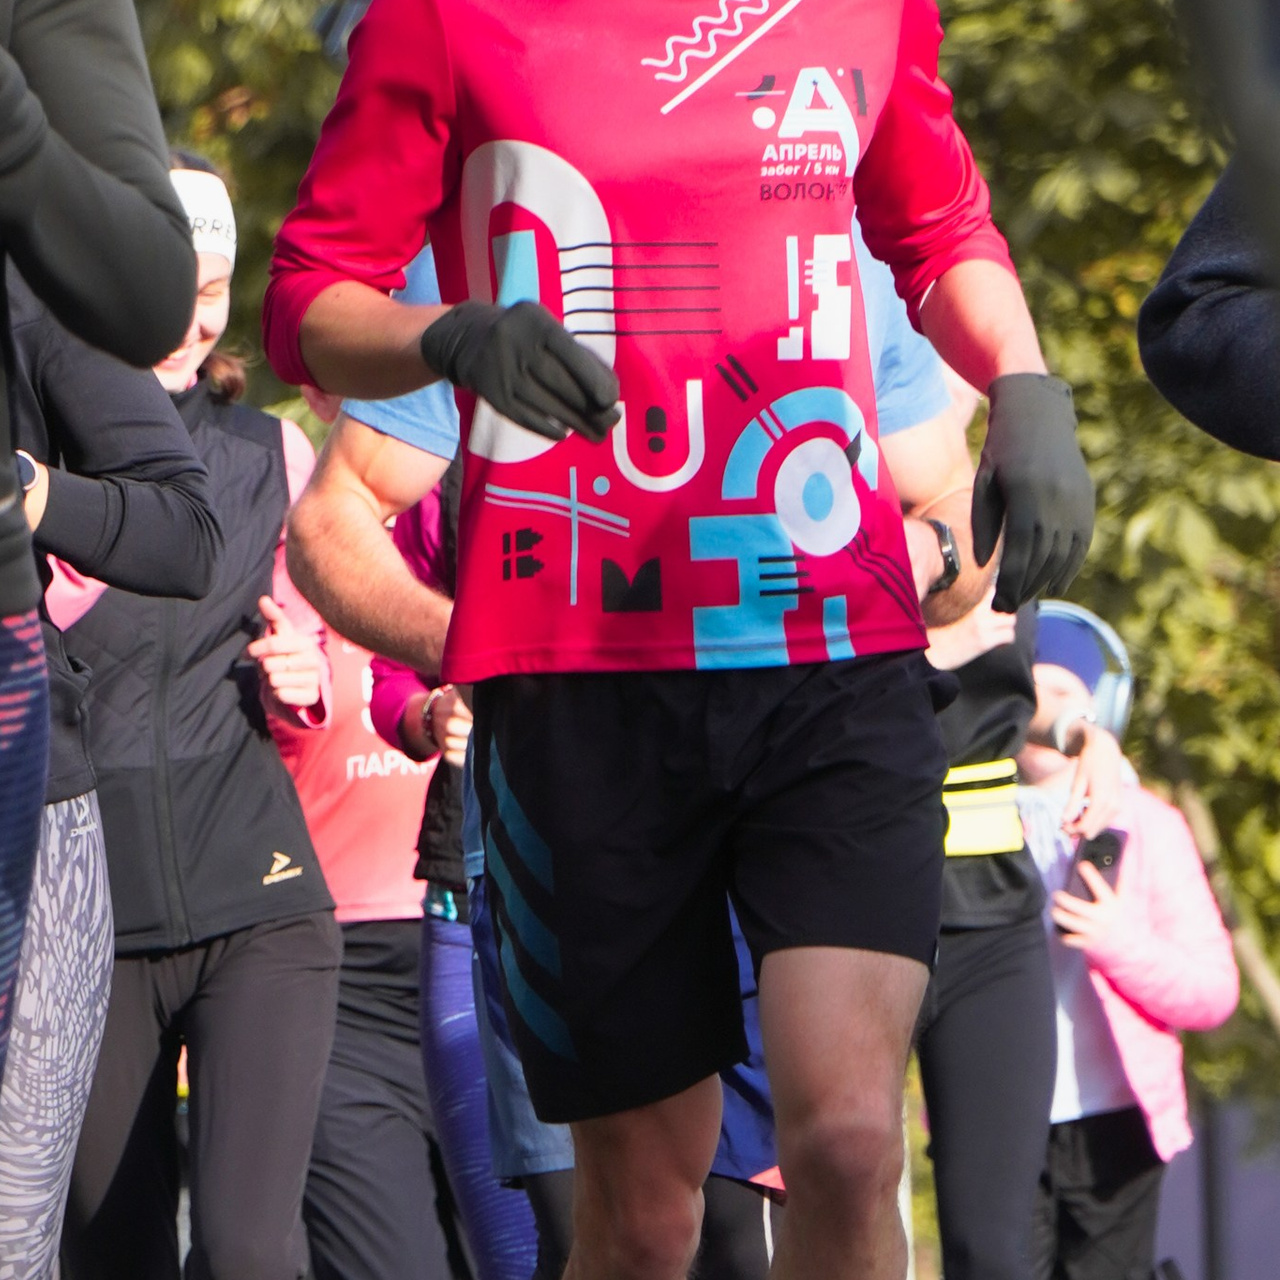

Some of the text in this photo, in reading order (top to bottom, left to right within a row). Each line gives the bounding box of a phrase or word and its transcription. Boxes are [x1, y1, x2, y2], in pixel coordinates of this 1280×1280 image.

[762, 143, 843, 162] АПРЕЛЬ
[760, 163, 801, 177] забег
[814, 162, 822, 176] 5
